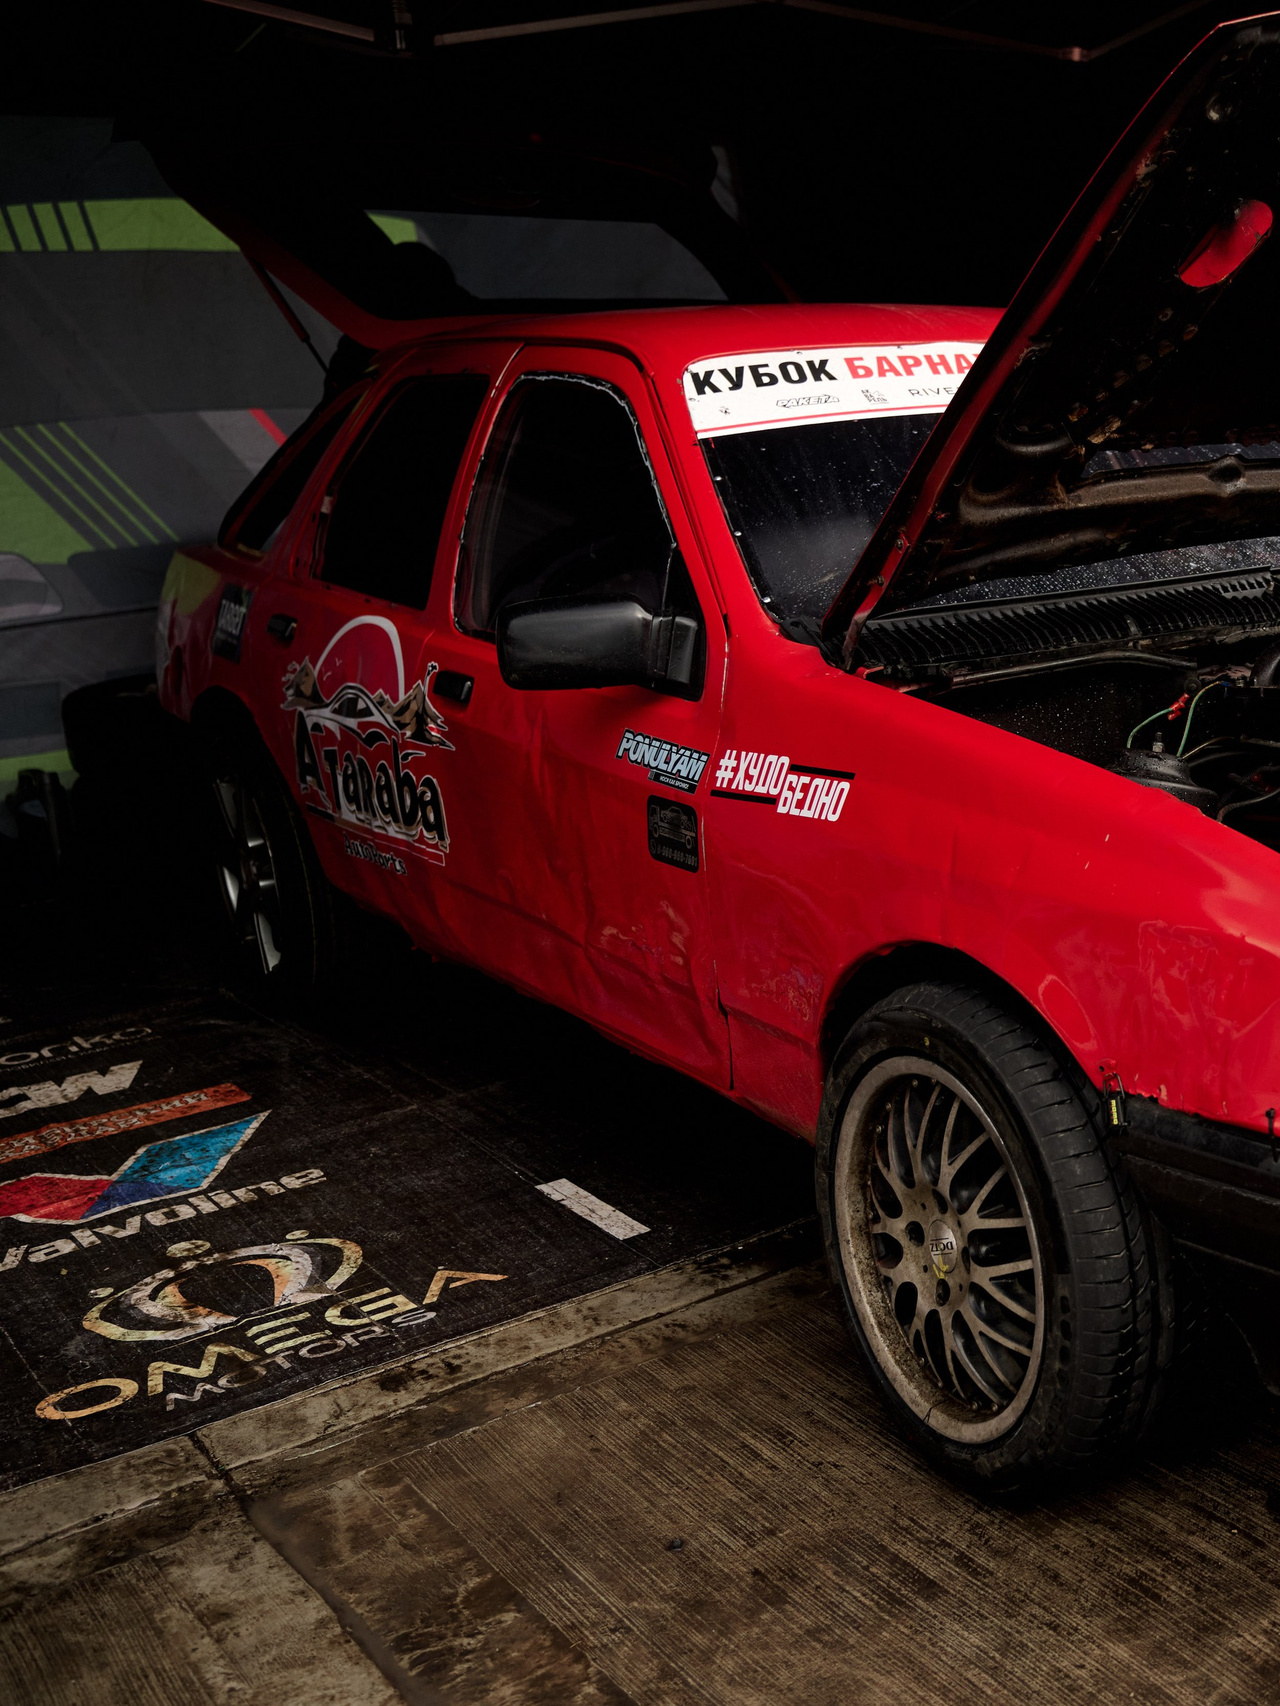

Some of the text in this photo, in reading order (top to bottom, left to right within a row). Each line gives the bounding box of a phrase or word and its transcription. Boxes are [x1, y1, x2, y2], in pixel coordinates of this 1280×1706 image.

[690, 353, 980, 396] КУБОК БАРНА
[908, 385, 958, 398] RIVE
[776, 774, 851, 822] БЕДНО
[35, 1266, 508, 1421] OMEGA
[166, 1310, 437, 1411] MOTORS
